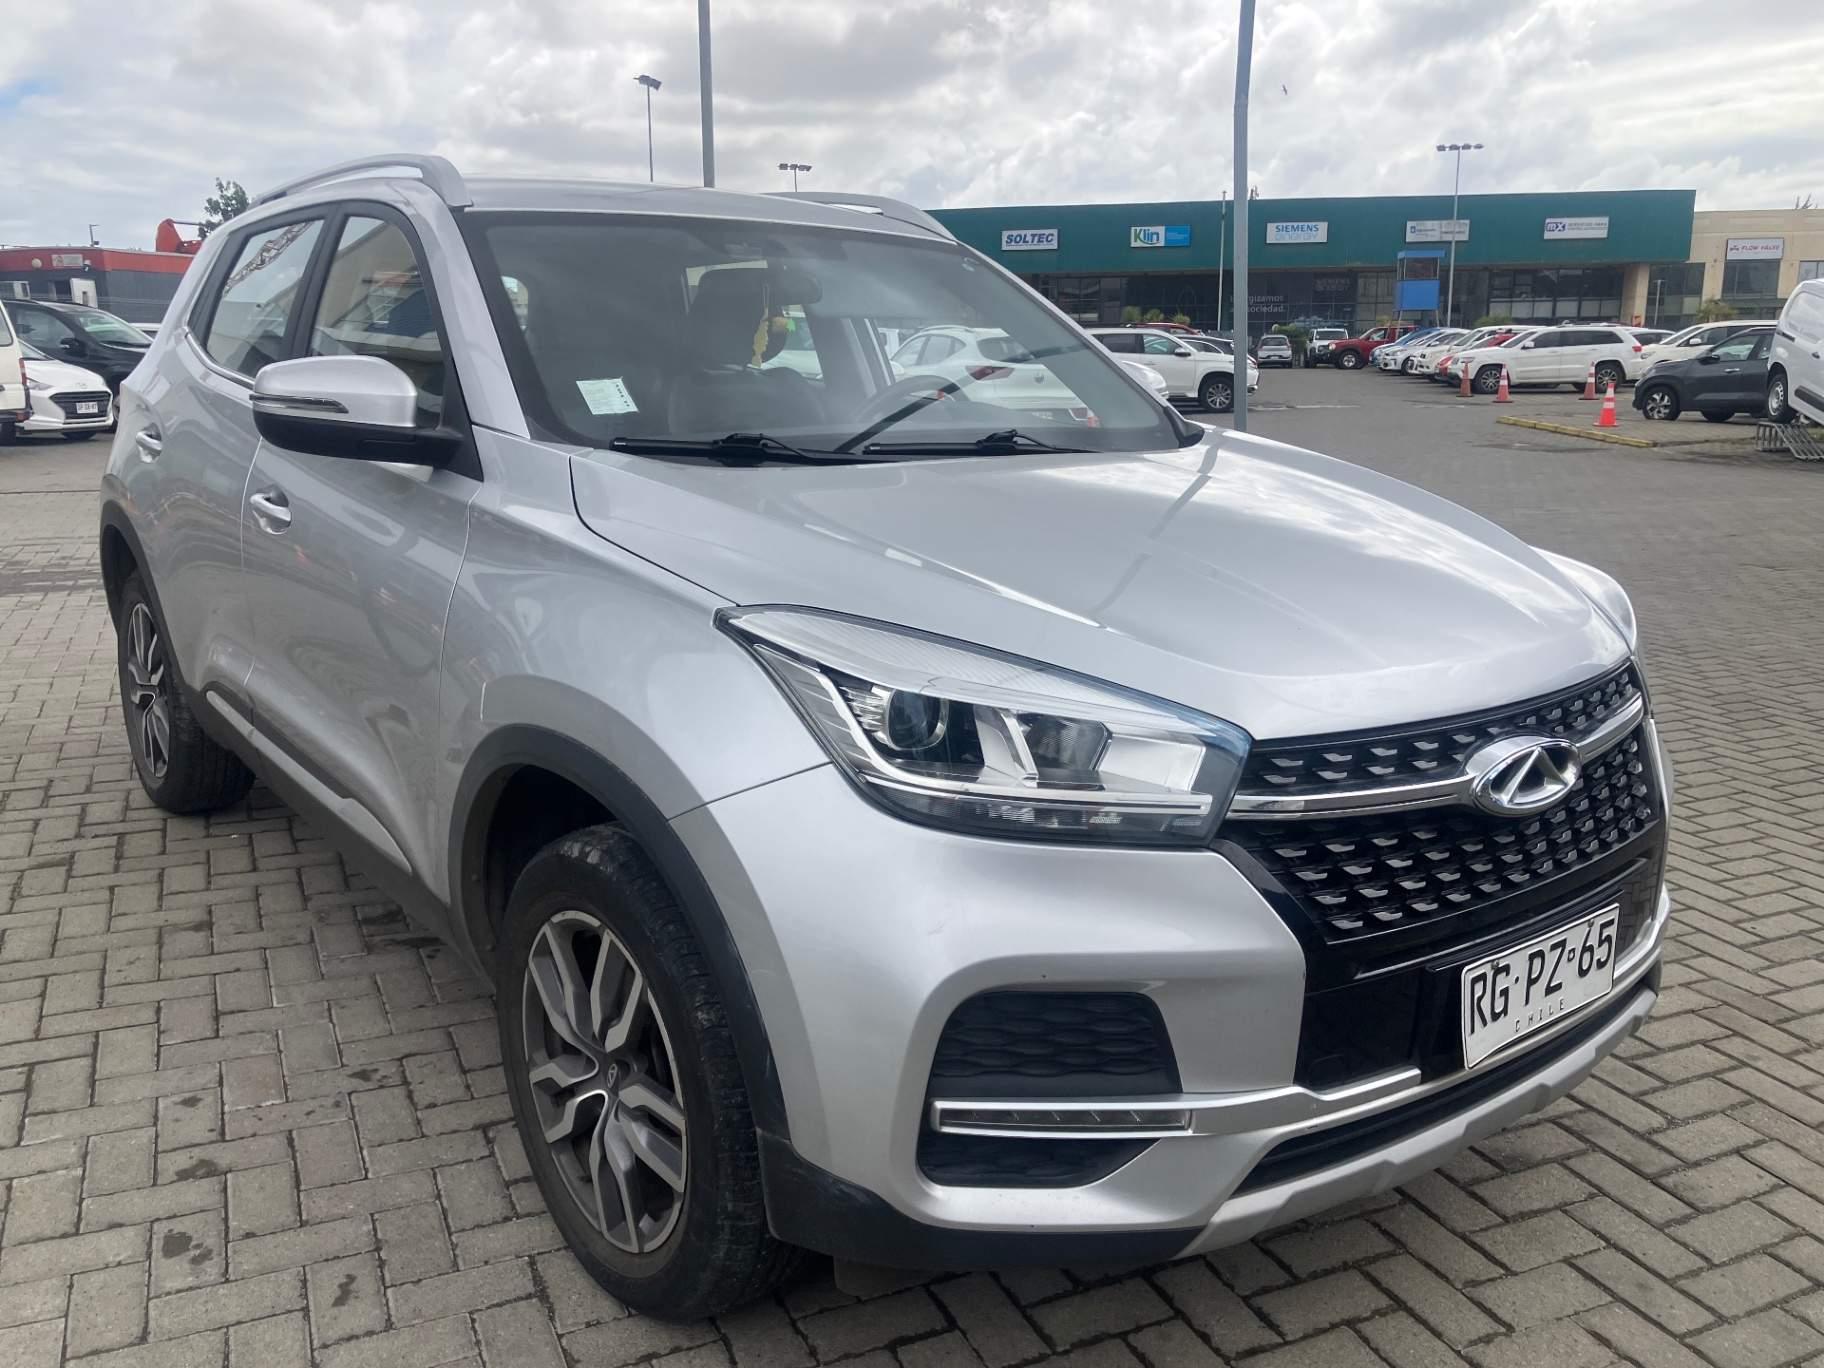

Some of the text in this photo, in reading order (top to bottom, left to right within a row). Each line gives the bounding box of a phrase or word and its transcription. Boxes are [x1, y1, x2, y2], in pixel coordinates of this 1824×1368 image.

[1275, 224, 1319, 233] SIEMENS
[1006, 233, 1055, 244] SOLTEC
[1133, 228, 1160, 245] Klin
[1515, 998, 1565, 1033] CHILE
